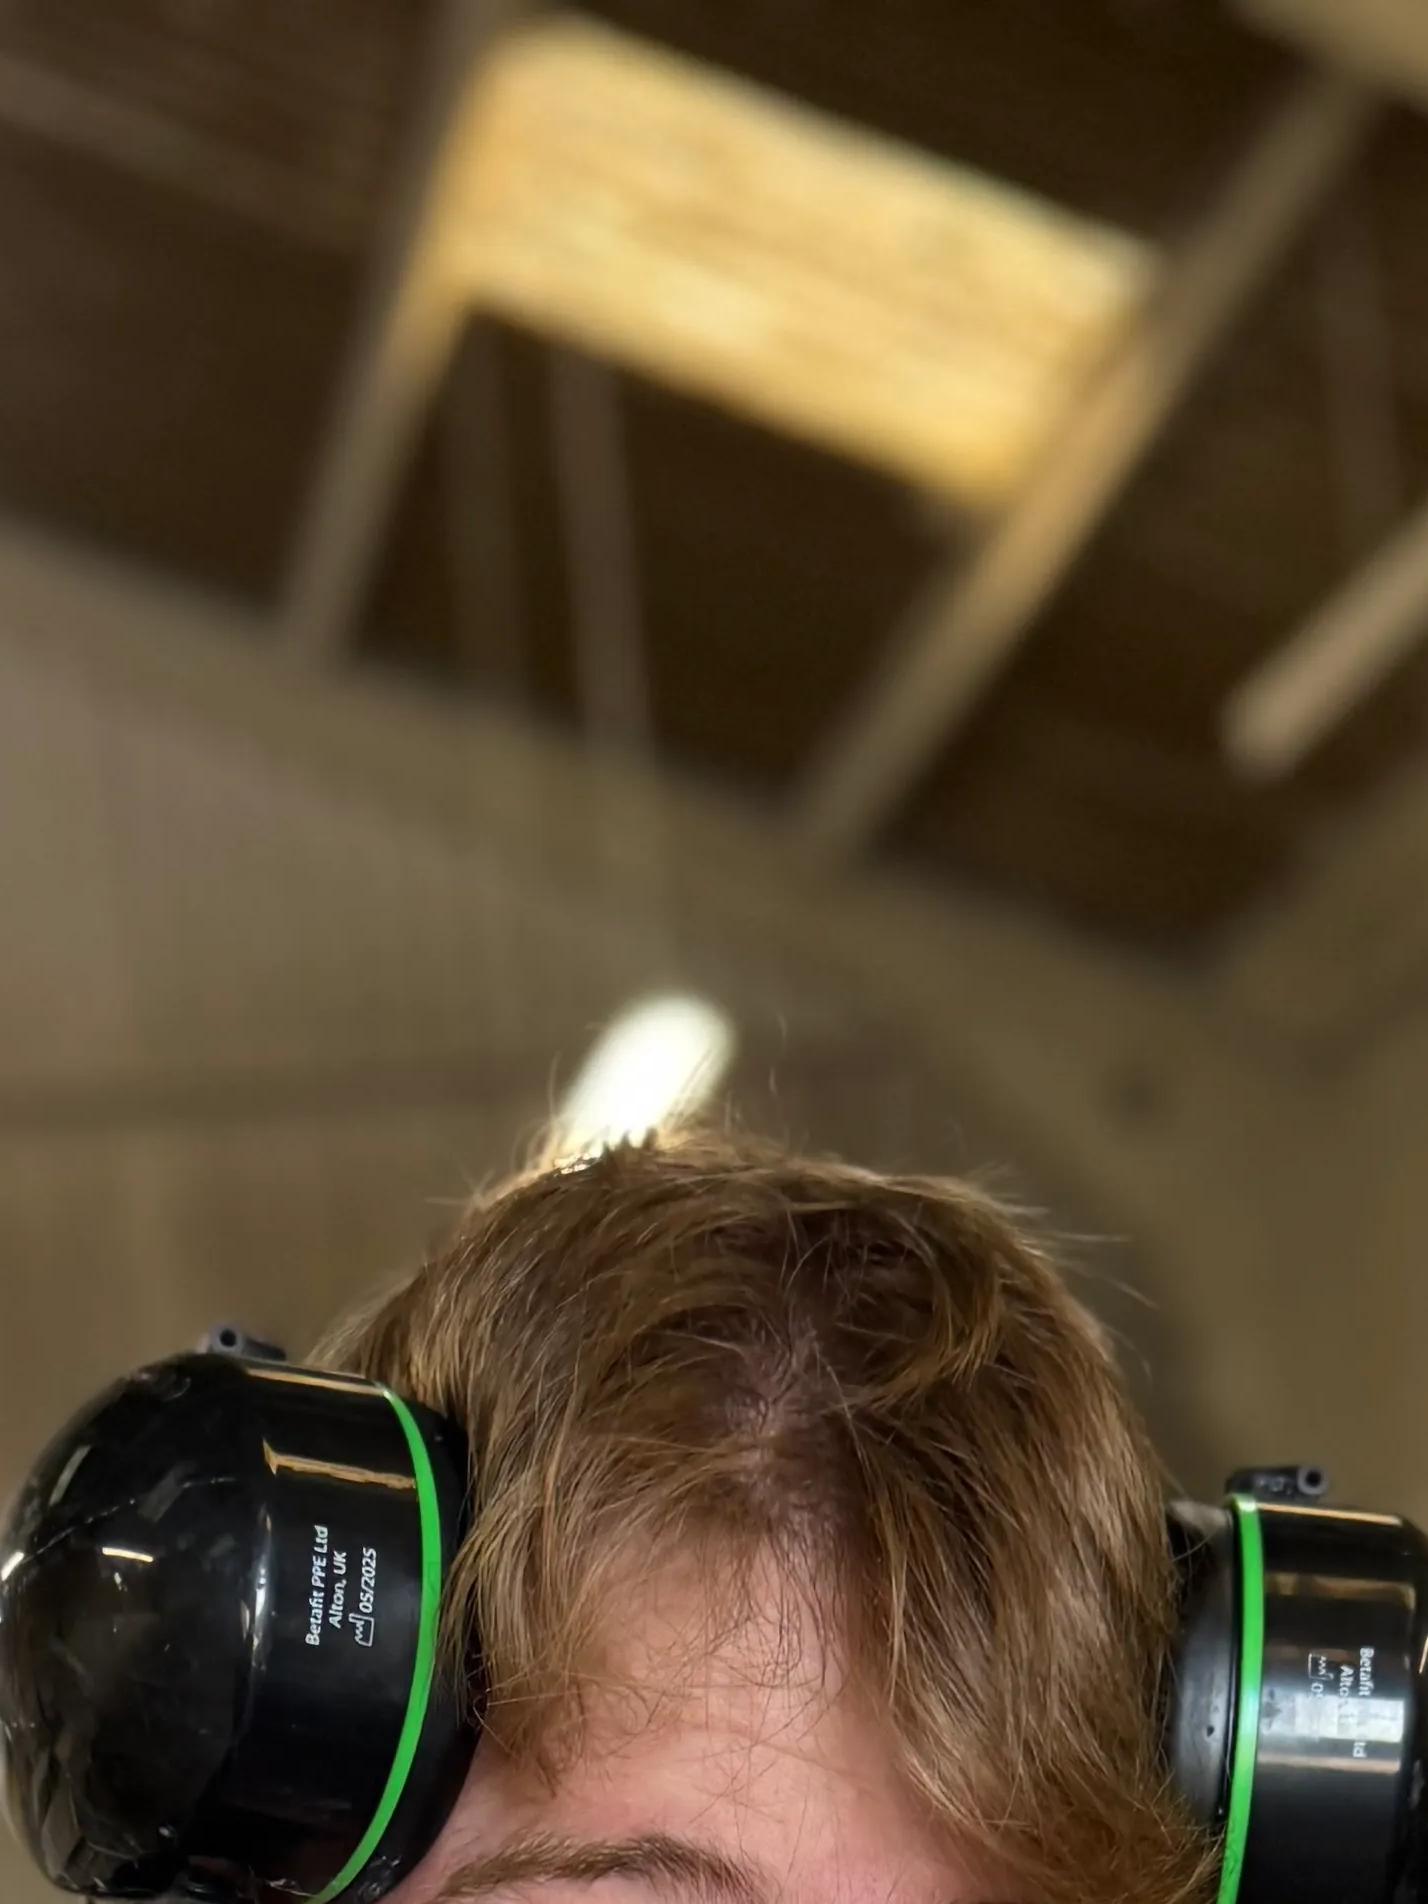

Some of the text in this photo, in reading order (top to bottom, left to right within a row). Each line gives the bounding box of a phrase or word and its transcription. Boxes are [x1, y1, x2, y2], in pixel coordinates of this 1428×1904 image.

[305, 1525, 328, 1645] Betafit PPE Ltd
[329, 1550, 347, 1629] Alton, UK
[359, 1547, 376, 1613] 05/2025
[1359, 1648, 1374, 1695] Betafit
